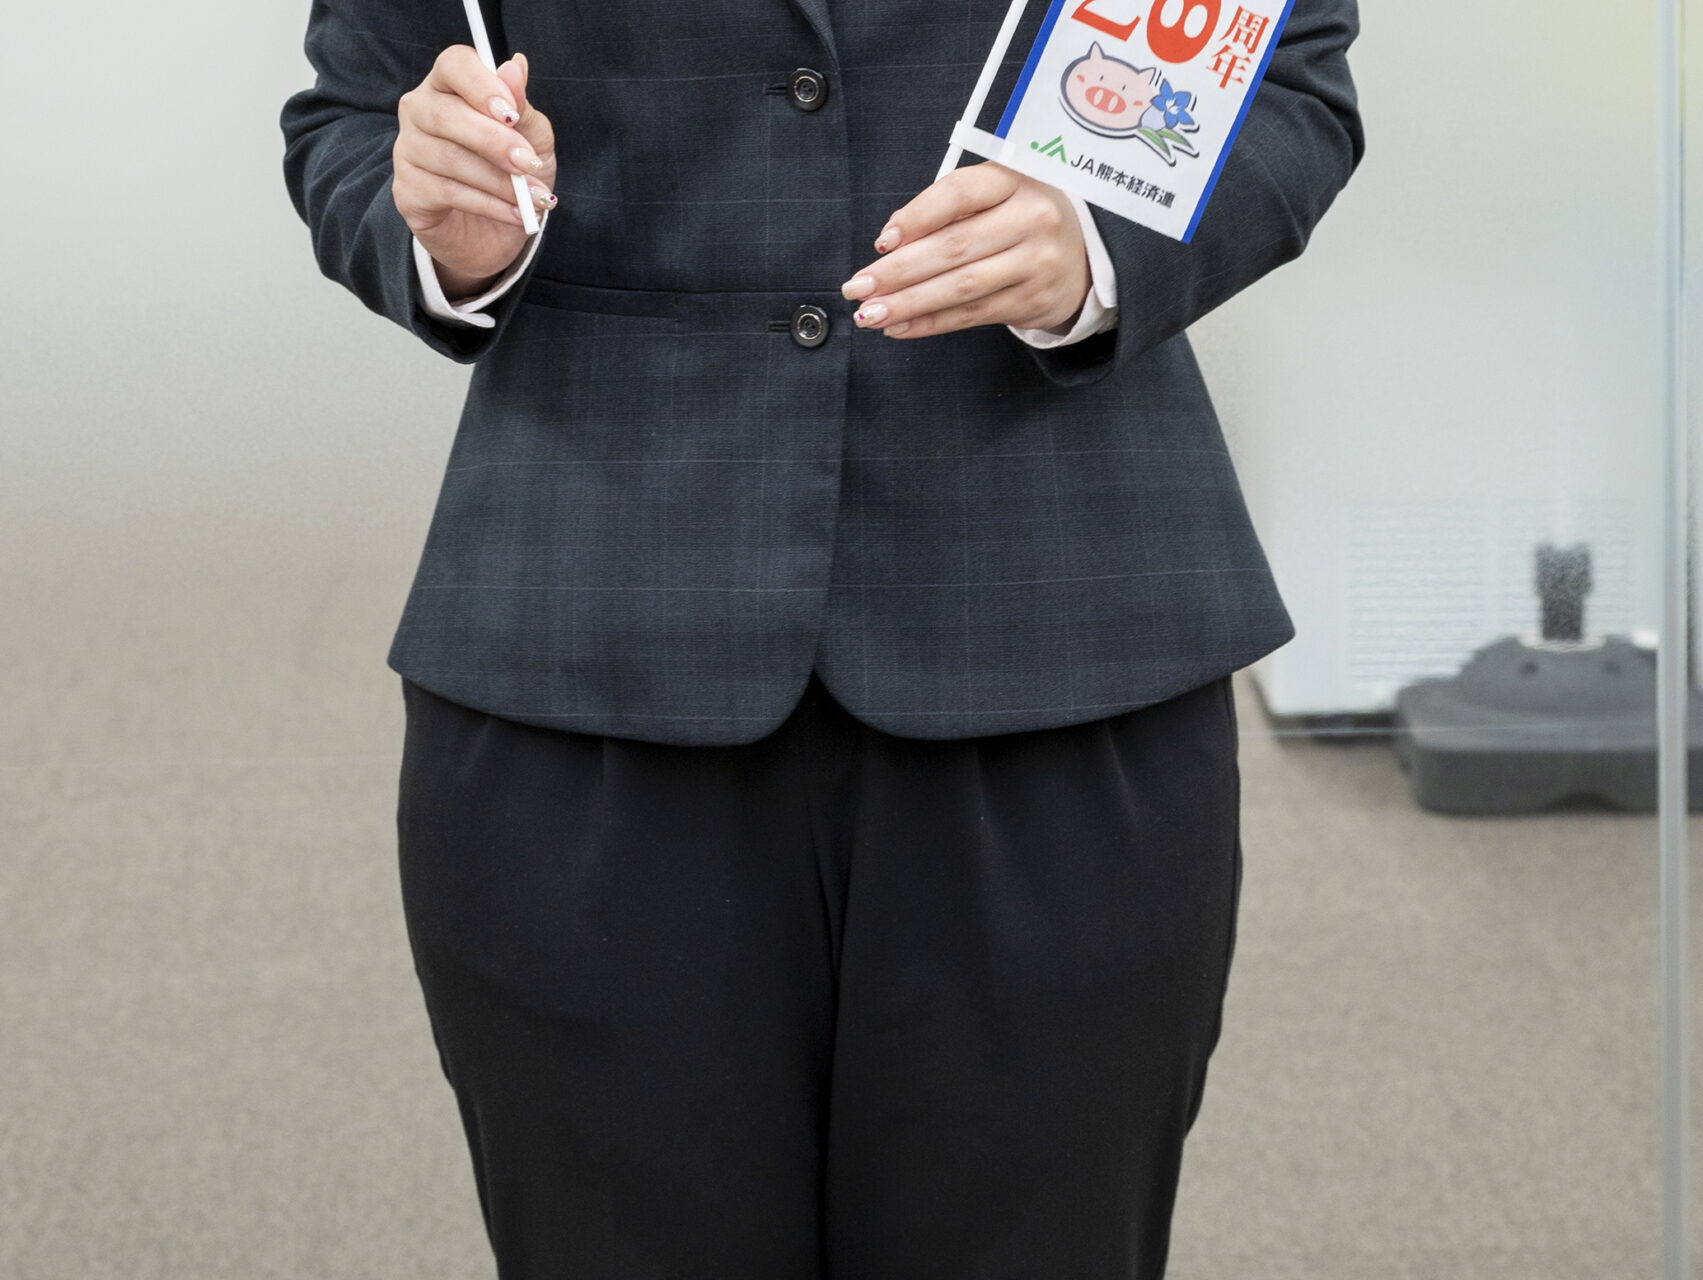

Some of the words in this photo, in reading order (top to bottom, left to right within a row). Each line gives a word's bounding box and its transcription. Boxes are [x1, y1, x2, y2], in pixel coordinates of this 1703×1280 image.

[1205, 4, 1270, 89] 周年
[1070, 154, 1176, 209] JA熊本経済連
